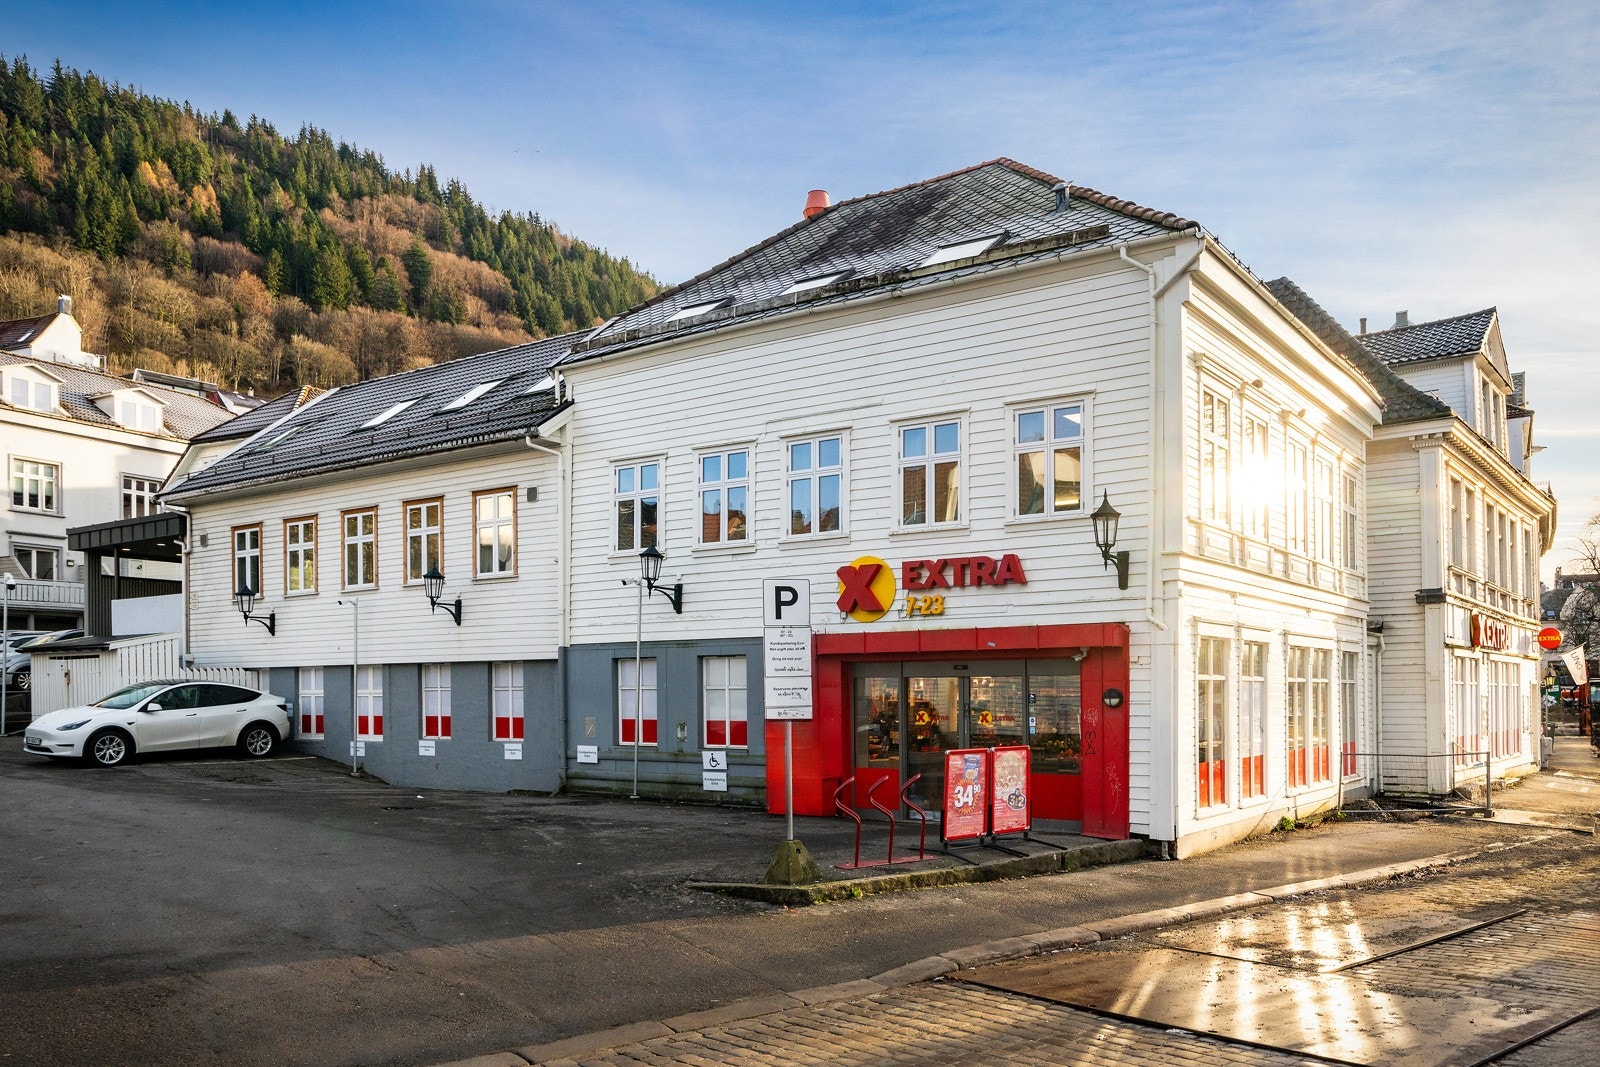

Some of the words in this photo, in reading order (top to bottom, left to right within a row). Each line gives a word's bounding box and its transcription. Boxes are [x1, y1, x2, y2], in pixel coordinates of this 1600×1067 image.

[902, 554, 1028, 590] EXTRA
[774, 586, 799, 620] P
[905, 594, 945, 618] 7-23
[954, 784, 974, 807] 34
